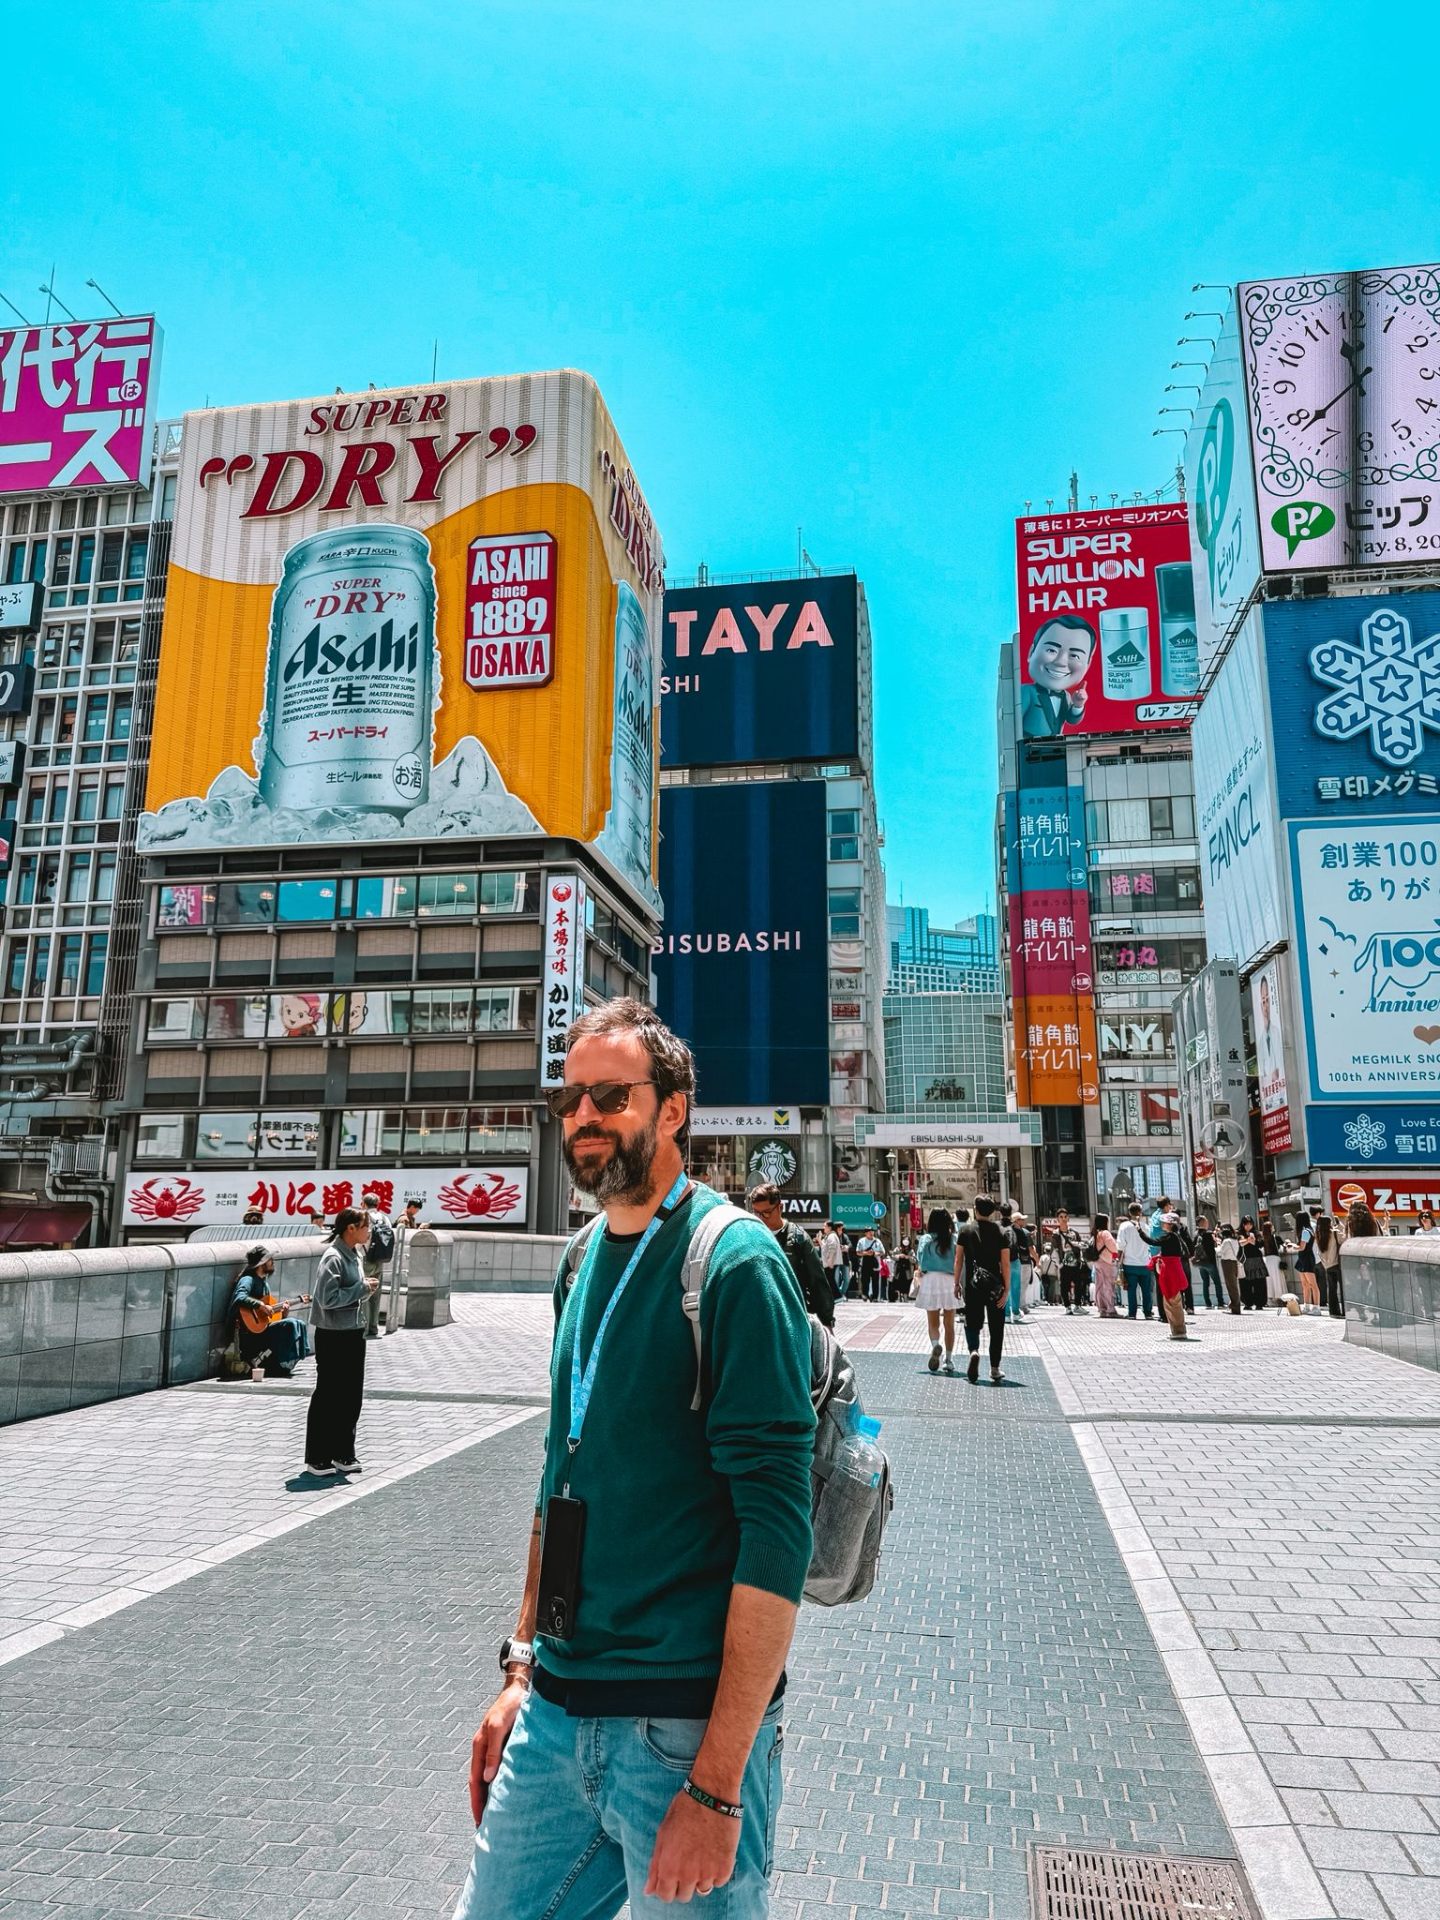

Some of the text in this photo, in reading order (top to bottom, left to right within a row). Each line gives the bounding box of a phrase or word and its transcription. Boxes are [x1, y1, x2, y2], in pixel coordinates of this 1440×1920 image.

[1304, 319, 1330, 342] 11
[1337, 310, 1366, 330] 12
[1383, 316, 1395, 333] 1
[1277, 342, 1306, 368] 10
[1405, 335, 1429, 353] 2
[1273, 380, 1297, 394] 9
[304, 393, 448, 436] SUPER
[1415, 397, 1438, 414] 4
[1287, 408, 1310, 426] 8
[1320, 427, 1342, 446] 7
[1391, 419, 1412, 441] 5
[1359, 432, 1374, 452] 6
[1345, 495, 1432, 531] ピップ
[343, 547, 371, 557] 辛口
[1027, 532, 1132, 561] SUPER
[1343, 540, 1390, 556] May.
[471, 545, 548, 586] ASAHI
[1027, 558, 1145, 587] MILLION
[333, 578, 381, 591] SUPER
[492, 585, 528, 599] since
[1029, 587, 1108, 612] HAIR
[471, 597, 548, 637] 1889
[668, 601, 834, 657] TAYA
[283, 618, 418, 684] Asahi
[470, 640, 546, 679] OSAKA
[1116, 654, 1138, 663] SMH
[332, 683, 366, 706] 生
[307, 726, 388, 742] スーパードライ
[326, 770, 361, 783] 生ビール
[1318, 769, 1439, 799] 雪印メグミ
[1020, 813, 1070, 836] 龍角散
[1209, 784, 1261, 887] FANCL
[1107, 873, 1154, 896] 焼肉
[1024, 916, 1076, 939] 龍角散
[552, 907, 570, 975] 本場の味
[1361, 996, 1440, 1013] Annive
[1029, 1024, 1081, 1046] 龍角散
[1102, 1023, 1158, 1051] NY
[1352, 1055, 1411, 1064] MEGMILK
[1329, 1072, 1362, 1082] 100th
[1401, 1118, 1427, 1127] Love
[911, 1135, 984, 1144] EBISU BASHI-SUJI
[1395, 1135, 1437, 1154] 雪印
[837, 1204, 869, 1213] @cosme
[1373, 1188, 1440, 1211] ZETT
